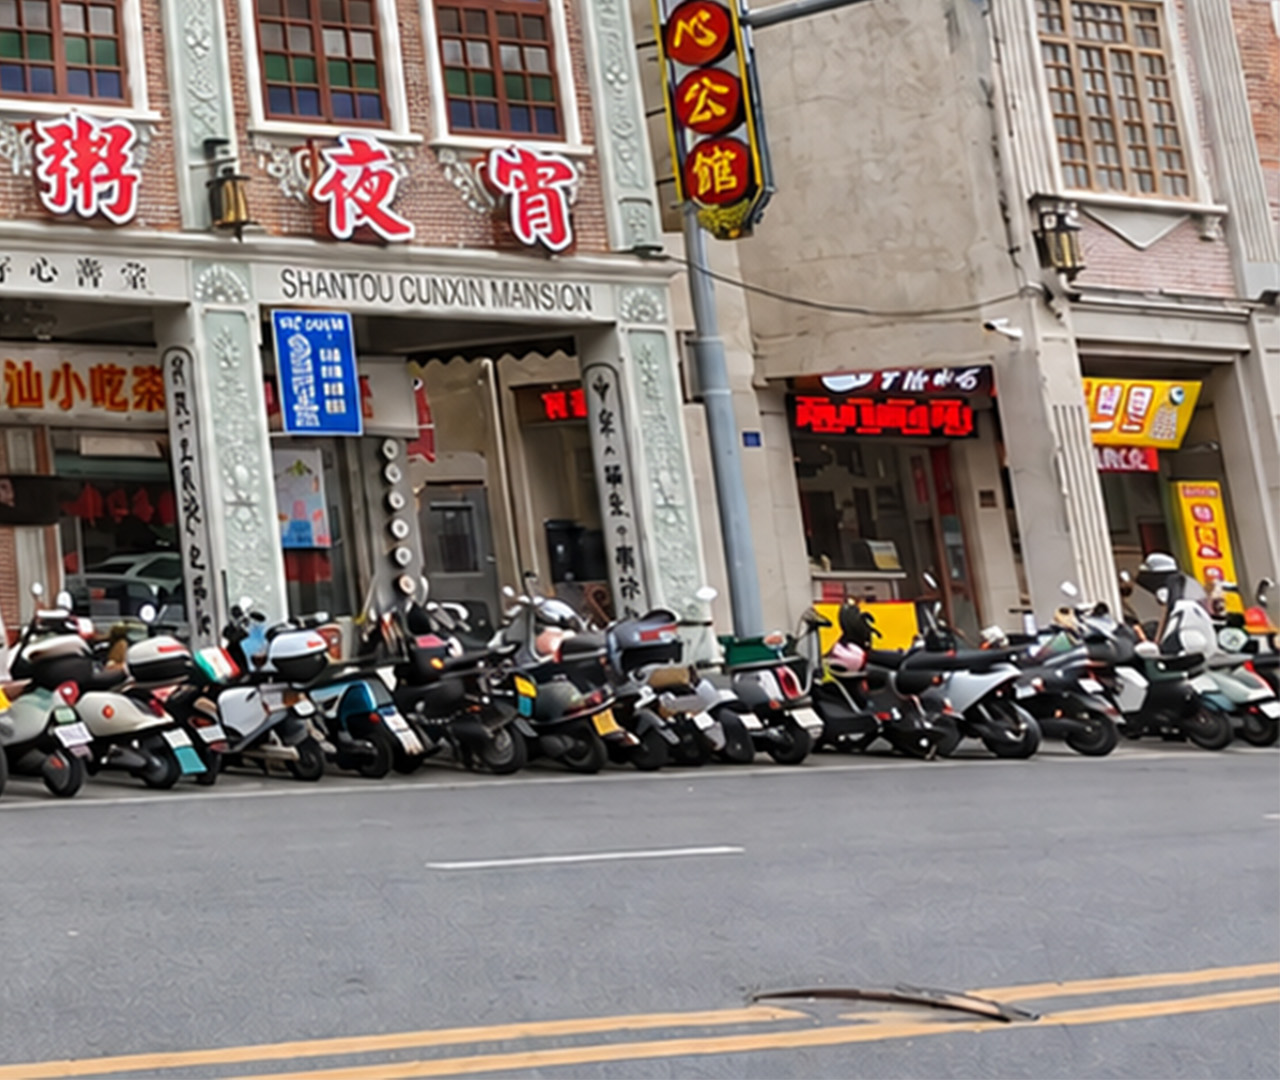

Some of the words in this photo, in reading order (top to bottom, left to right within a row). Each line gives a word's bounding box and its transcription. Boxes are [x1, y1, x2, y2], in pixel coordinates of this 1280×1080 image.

[281, 269, 393, 303] SHANTOU
[399, 276, 485, 306] CUNXIN
[490, 281, 593, 312] MANSION
